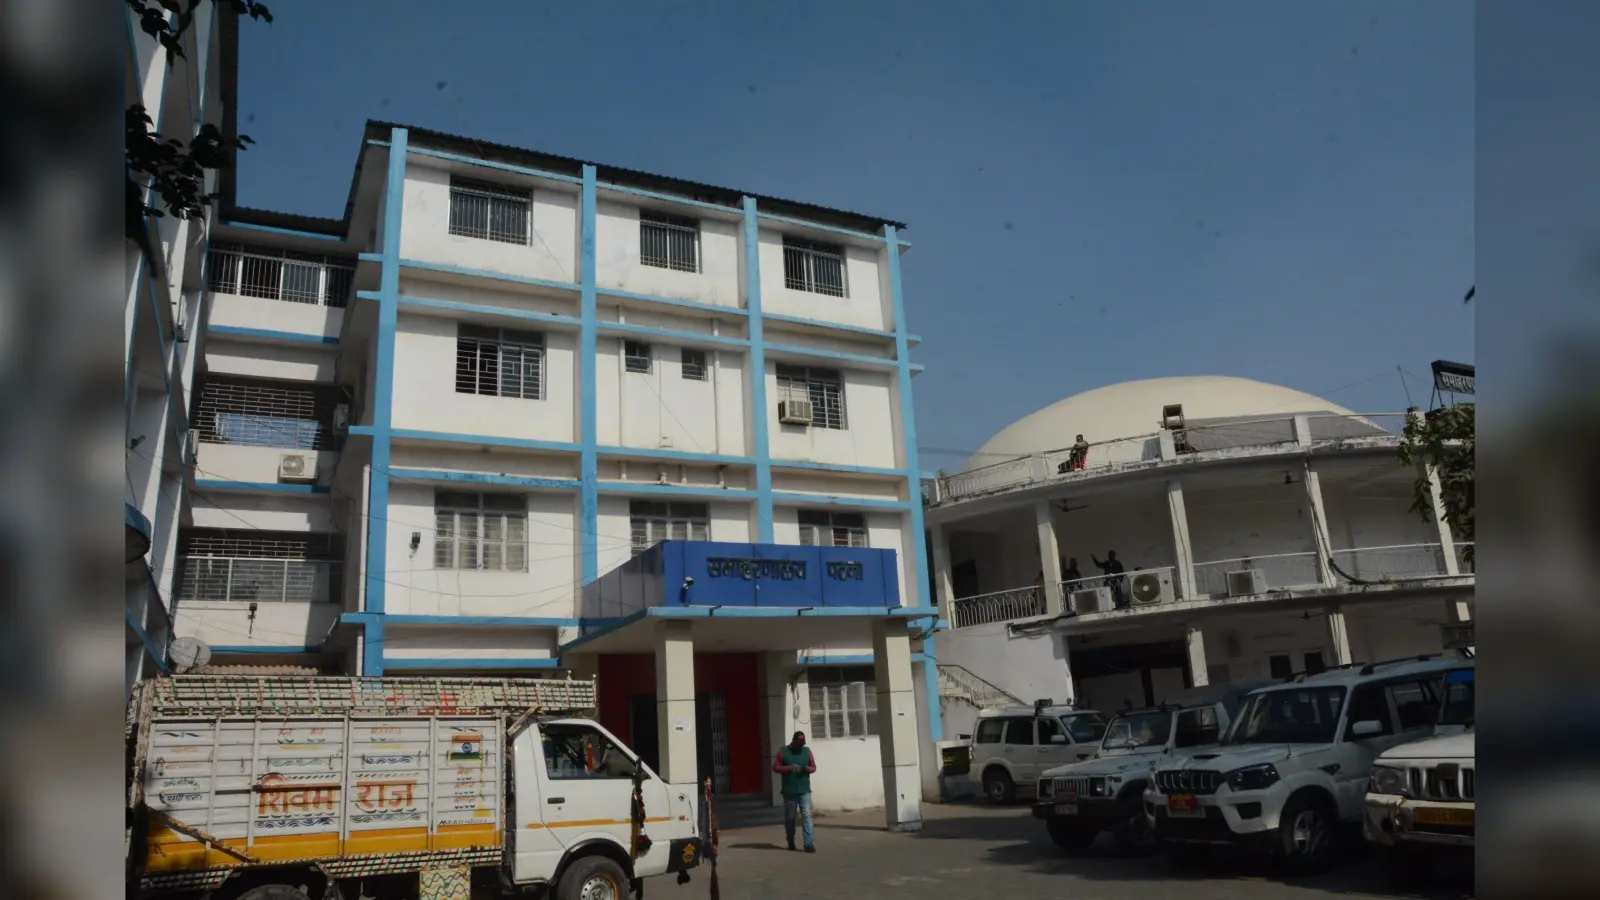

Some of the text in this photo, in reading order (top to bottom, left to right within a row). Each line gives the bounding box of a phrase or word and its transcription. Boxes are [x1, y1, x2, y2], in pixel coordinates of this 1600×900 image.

[706, 557, 864, 580] समाहरणालय पटना
[257, 773, 417, 815] शिवम राज
